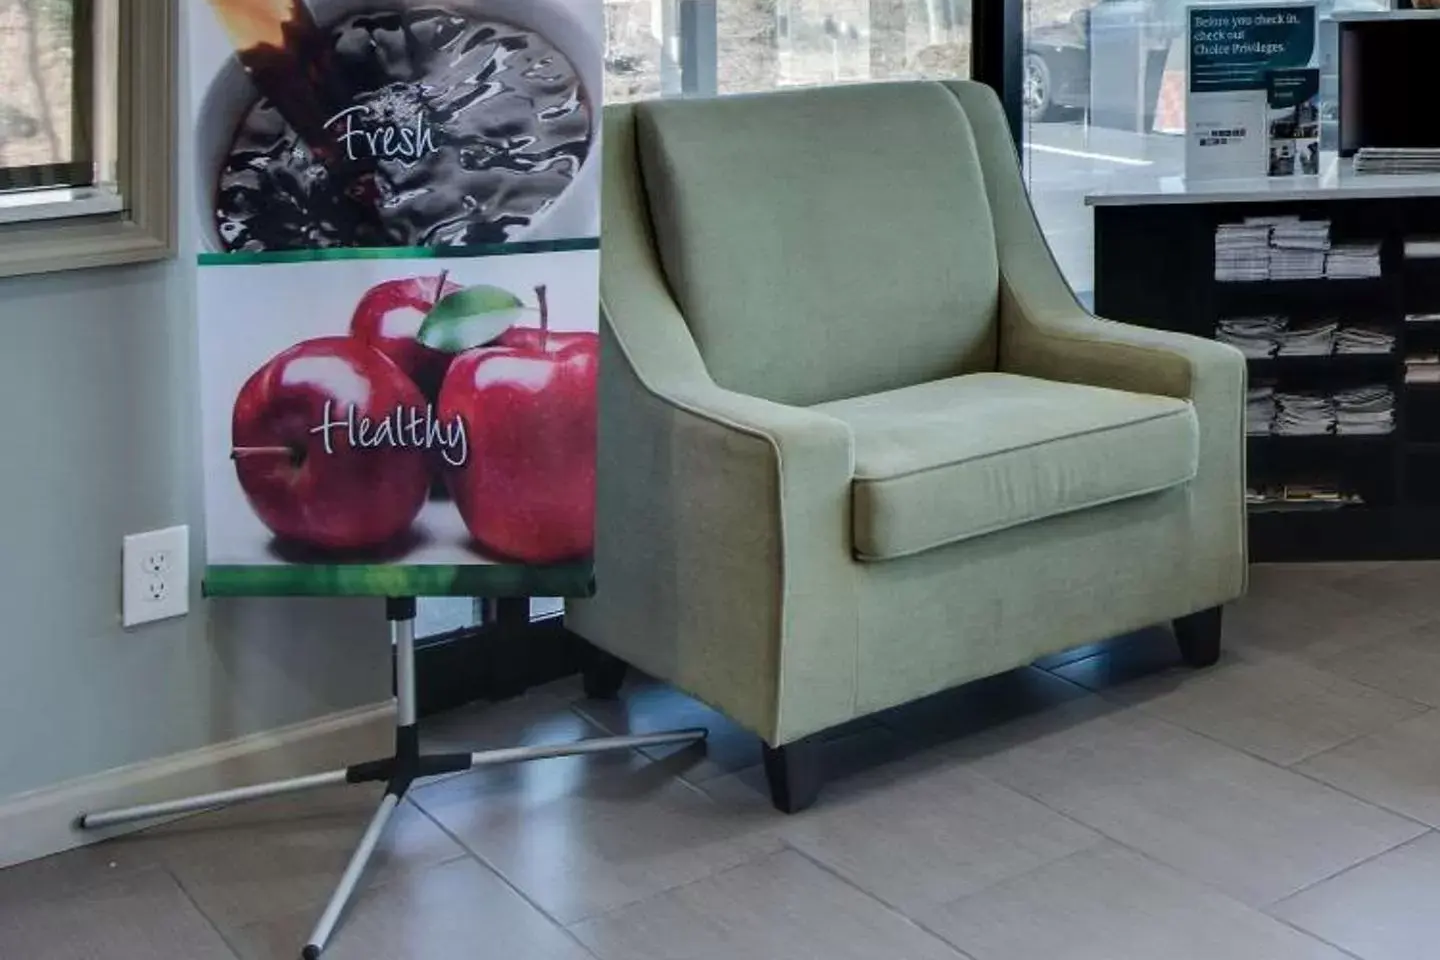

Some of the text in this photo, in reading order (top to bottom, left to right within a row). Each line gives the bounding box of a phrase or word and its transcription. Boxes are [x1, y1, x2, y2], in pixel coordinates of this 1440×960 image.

[1194, 16, 1229, 28] Before
[1231, 16, 1252, 30] you
[1254, 14, 1284, 26] check
[1193, 29, 1225, 41] check
[1193, 43, 1230, 55] Choice
[323, 105, 440, 161] Fresh
[310, 399, 468, 466] Healthy
